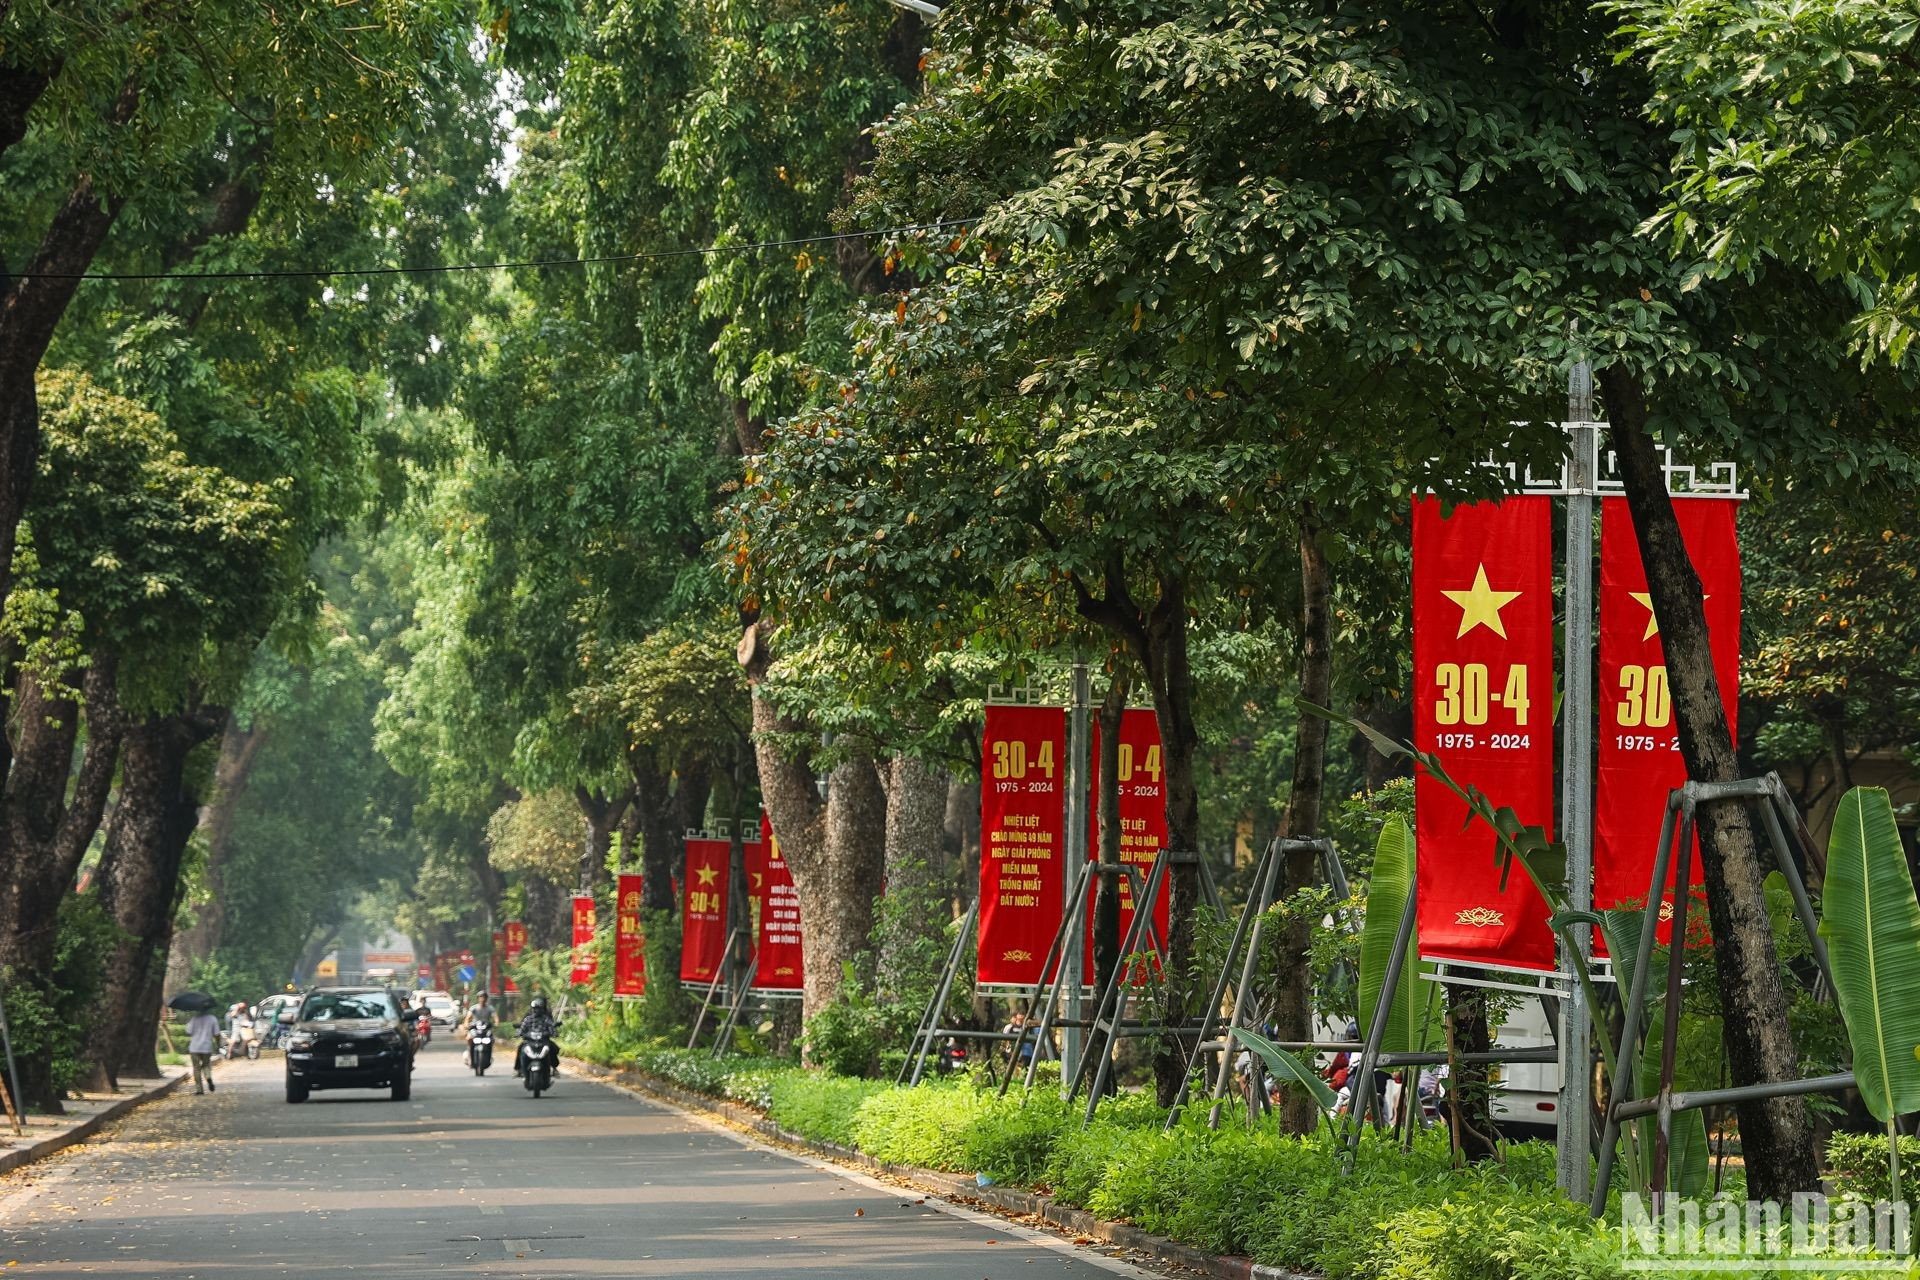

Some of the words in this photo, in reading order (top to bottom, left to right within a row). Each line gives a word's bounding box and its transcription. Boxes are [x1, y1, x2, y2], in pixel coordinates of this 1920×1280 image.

[1435, 663, 1531, 726] 30-4
[1435, 733, 1475, 749] 1975
[1490, 734, 1531, 749] 2024
[1615, 735, 1655, 751] 1975
[992, 740, 1055, 779] 30-4
[1118, 743, 1161, 783] 0-4
[995, 782, 1019, 793] 1975
[1028, 782, 1054, 793] 2024
[1134, 785, 1159, 797] 2024
[1025, 813, 1040, 830] LIỆT
[1131, 817, 1146, 833] LIỆT
[1028, 832, 1037, 843] 49
[1135, 835, 1143, 847] 49
[690, 891, 720, 913] 30-4
